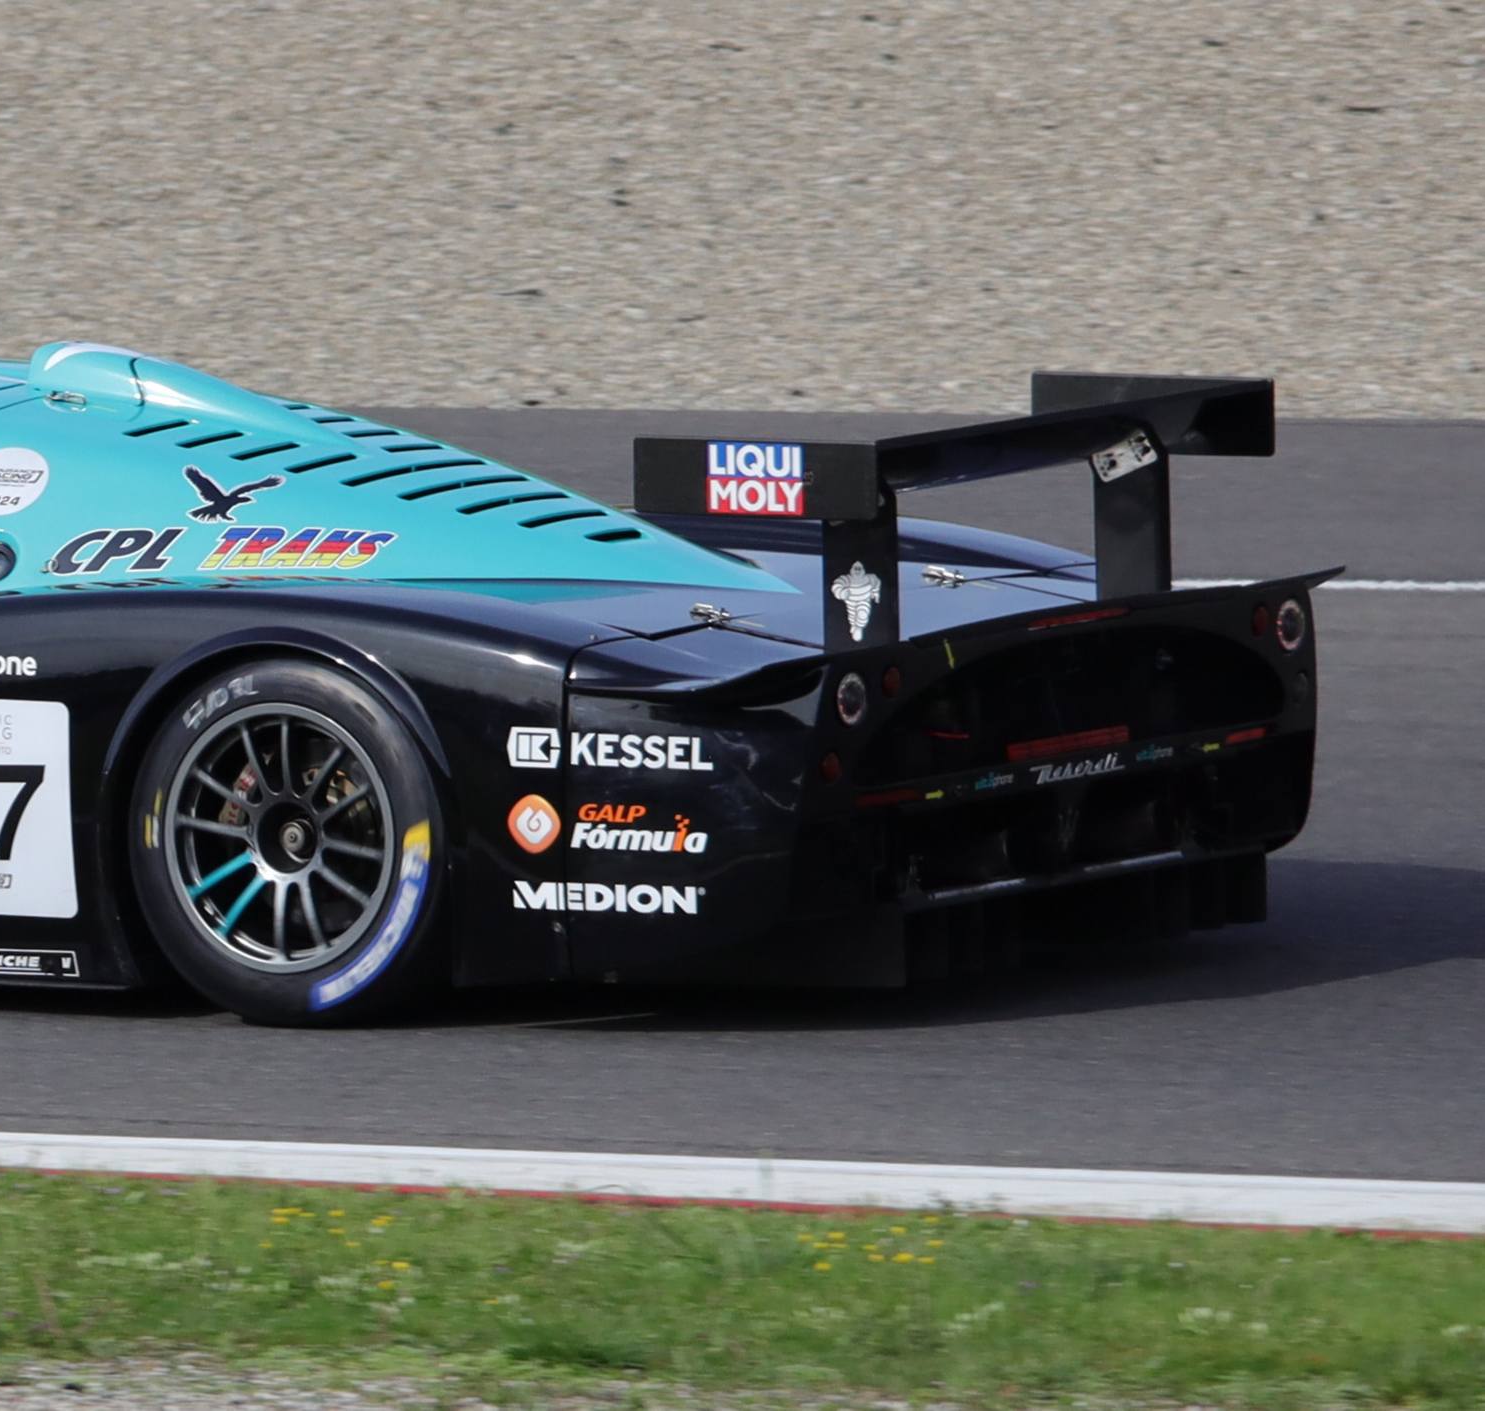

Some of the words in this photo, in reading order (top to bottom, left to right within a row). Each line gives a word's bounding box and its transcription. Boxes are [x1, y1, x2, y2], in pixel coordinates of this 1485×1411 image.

[708, 444, 802, 478] LIQUI
[709, 480, 804, 513] MOLY
[50, 526, 189, 576] CPL
[198, 526, 400, 571] TRANS
[570, 731, 714, 771] KESSEL
[578, 803, 647, 823] GALP
